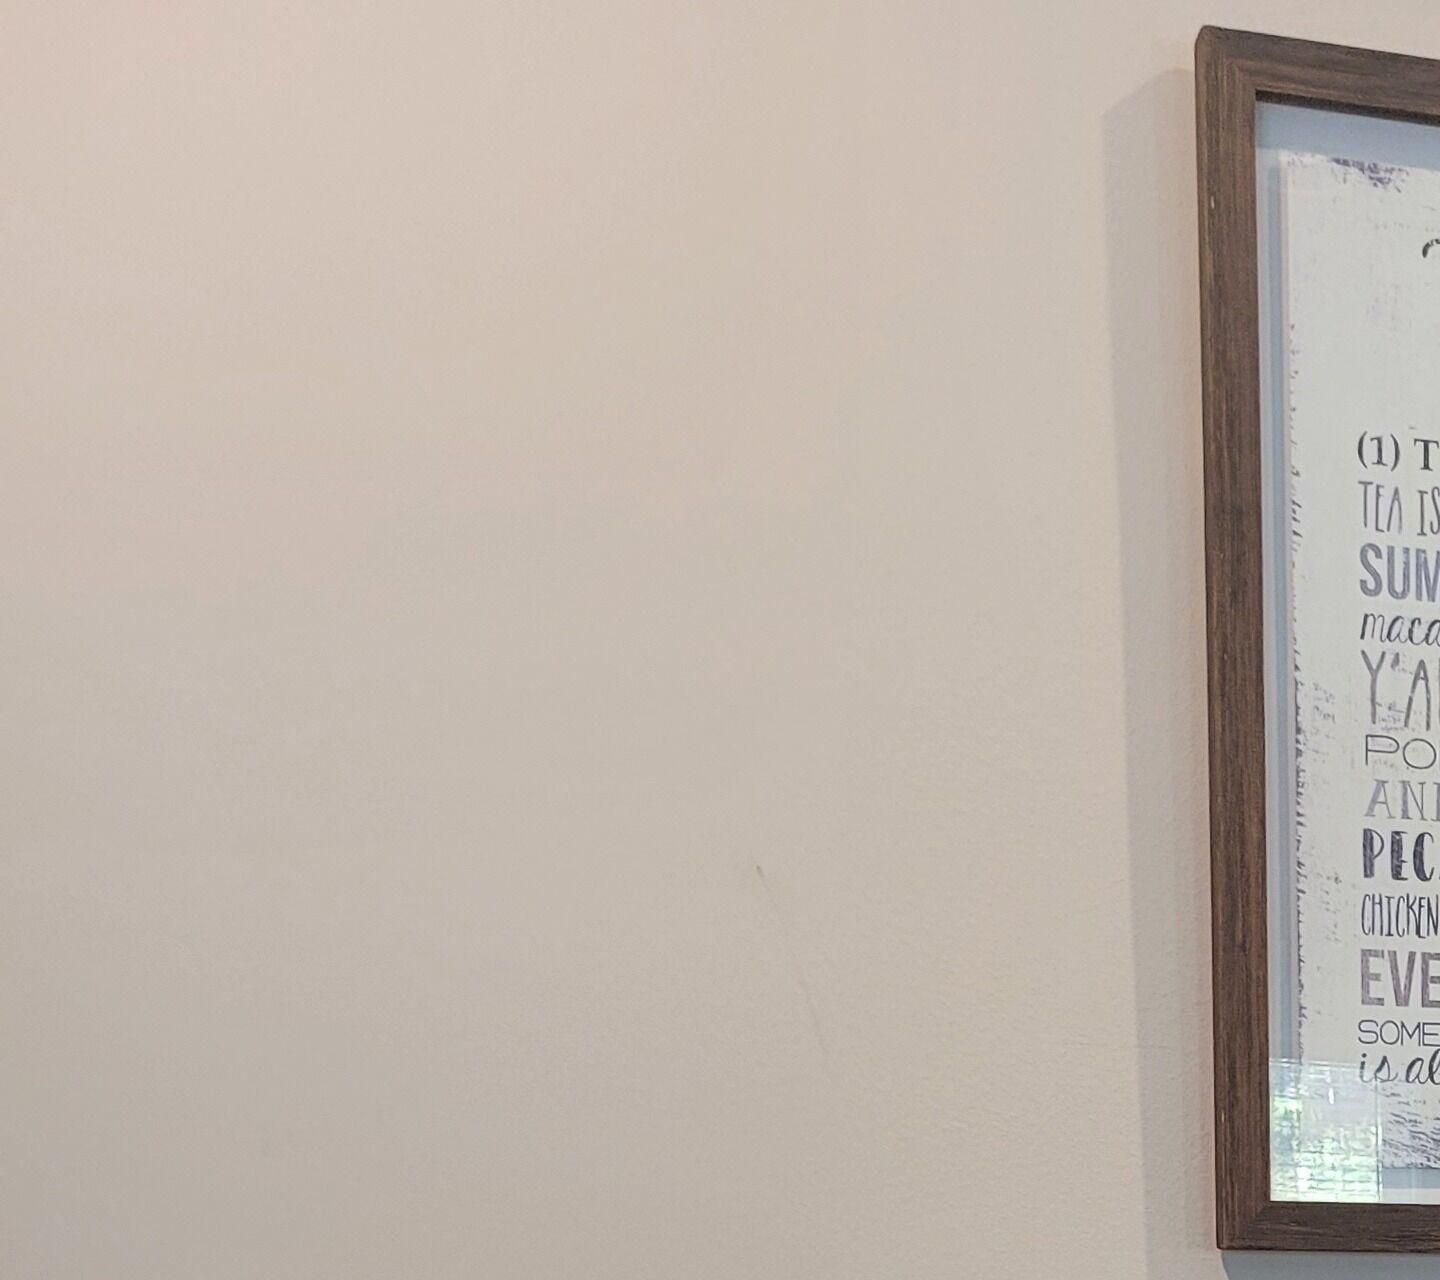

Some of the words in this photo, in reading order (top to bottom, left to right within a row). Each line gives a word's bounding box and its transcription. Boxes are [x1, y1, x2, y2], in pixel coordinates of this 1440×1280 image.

[1356, 430, 1402, 473] (1)
[1357, 479, 1403, 534] TEA
[1360, 892, 1440, 940] CHICKEN
[1358, 1052, 1398, 1085] is
